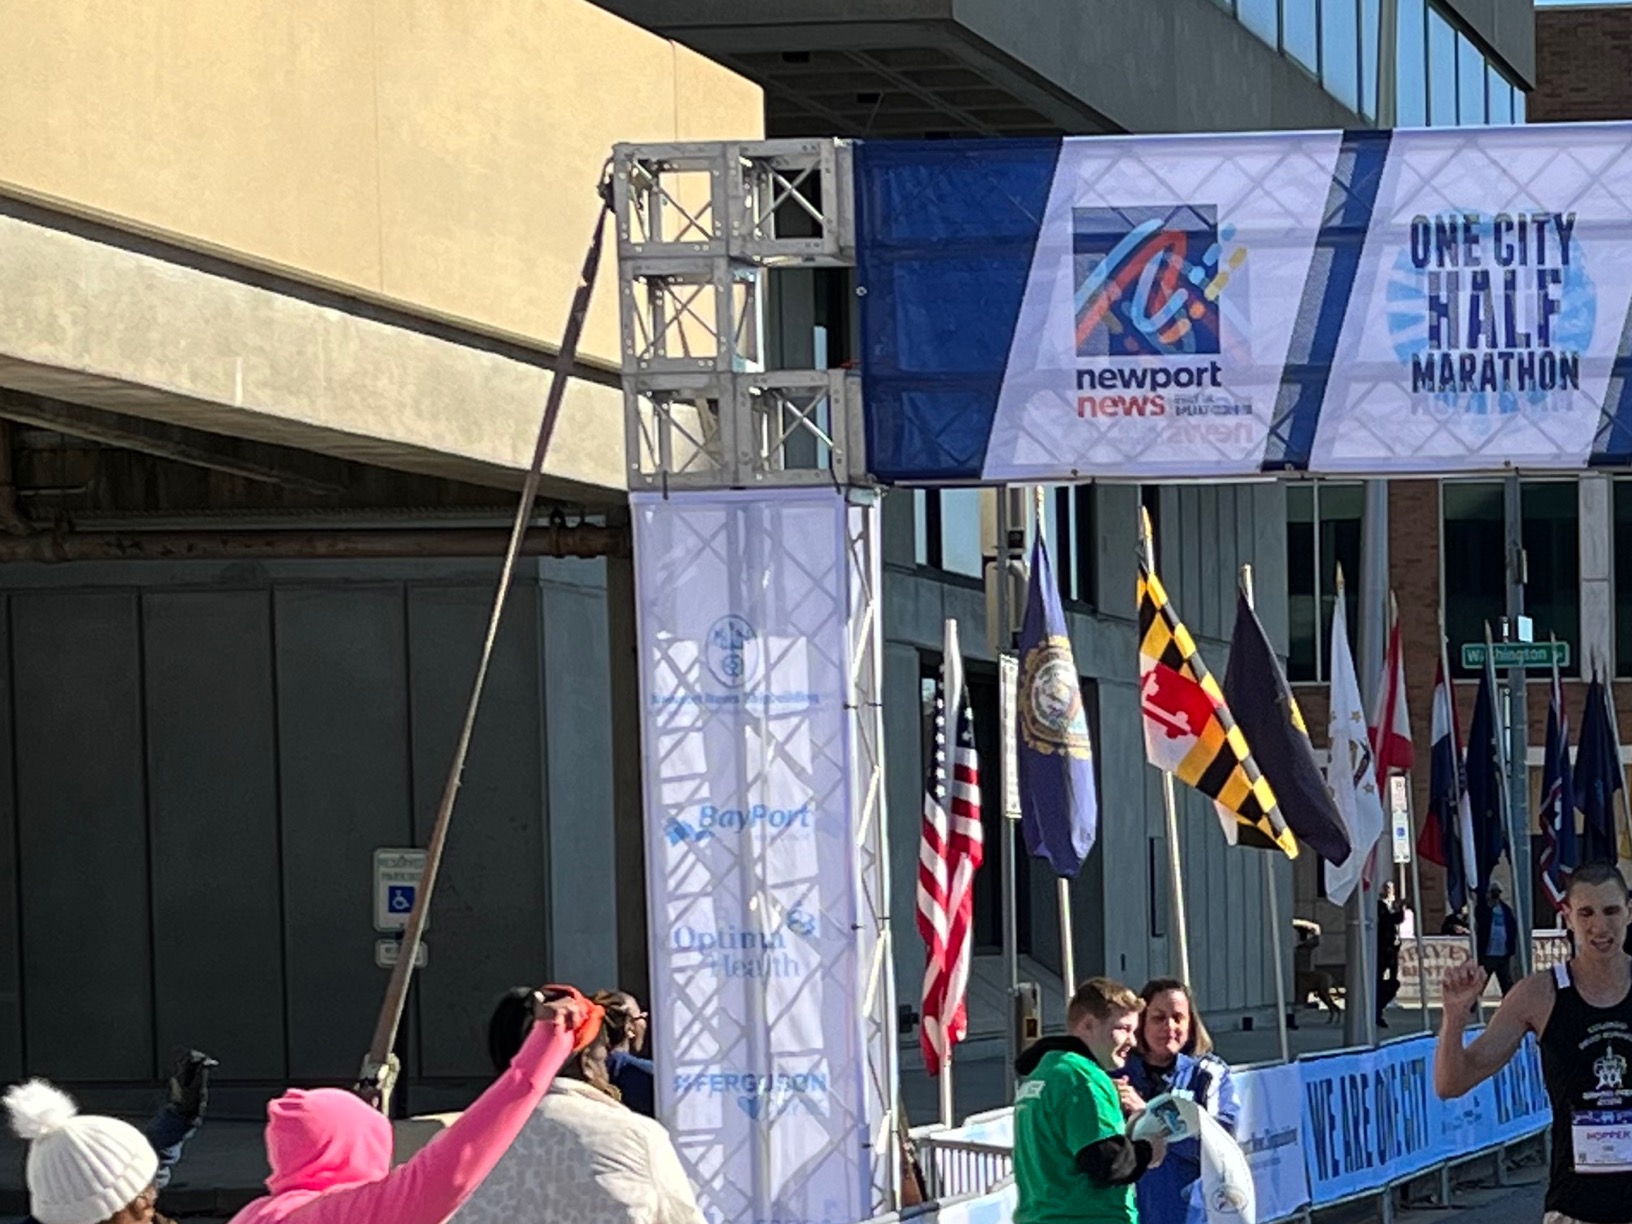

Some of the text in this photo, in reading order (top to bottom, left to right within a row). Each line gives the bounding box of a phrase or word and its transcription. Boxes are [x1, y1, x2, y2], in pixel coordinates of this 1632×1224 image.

[1410, 210, 1577, 269] ONE CITY
[1429, 268, 1562, 350] HALF
[1076, 361, 1222, 392] newport
[1412, 351, 1580, 393] MARATHON
[1077, 394, 1166, 418] news
[700, 803, 810, 833] BayPort
[674, 925, 788, 956] Optima
[711, 952, 800, 978] Health
[697, 1073, 828, 1093] FERGUSON
[1306, 1078, 1340, 1181] WE
[1340, 1073, 1373, 1173] ARE
[1374, 1063, 1402, 1166] ONE
[1401, 1056, 1429, 1155] CITY
